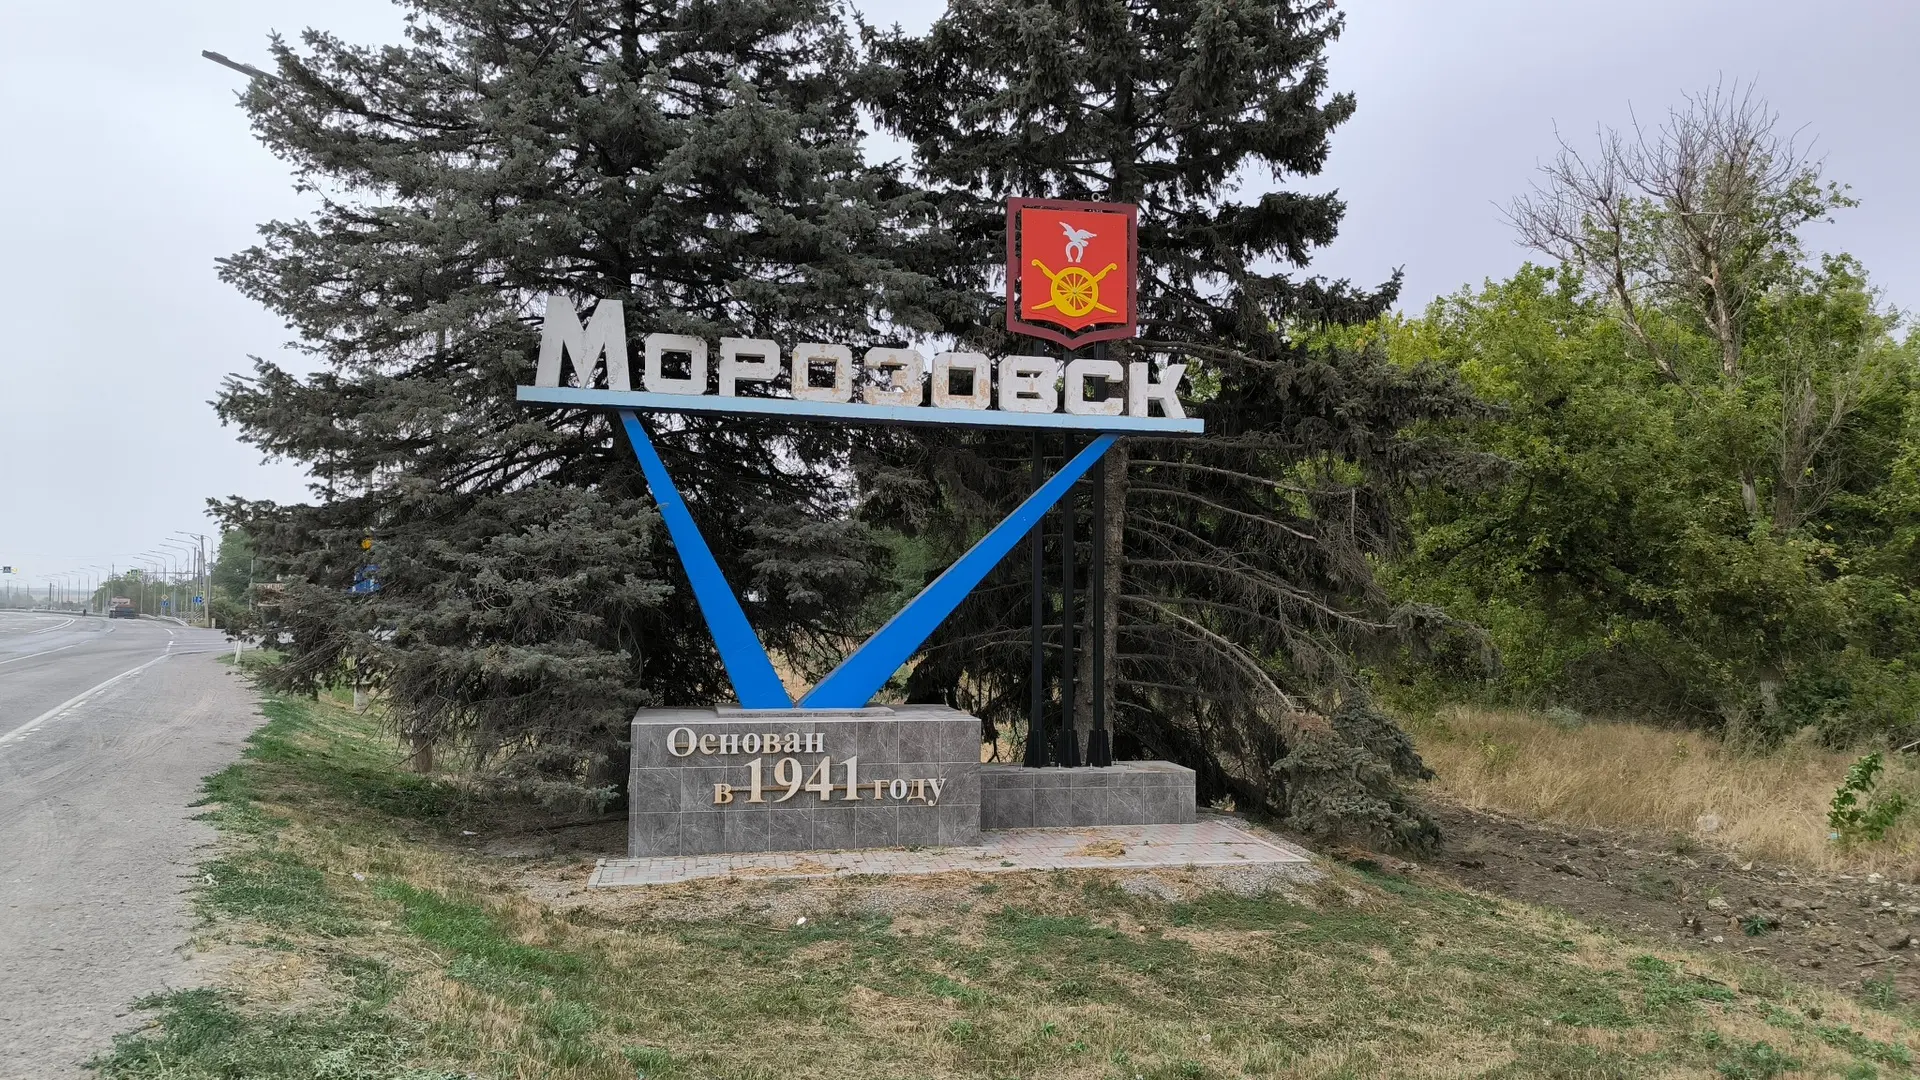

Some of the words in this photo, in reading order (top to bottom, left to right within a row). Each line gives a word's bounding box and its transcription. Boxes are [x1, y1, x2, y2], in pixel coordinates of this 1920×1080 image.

[667, 727, 825, 757] Основан
[713, 783, 734, 804] в
[744, 755, 862, 804] 1941
[873, 777, 947, 807] году
